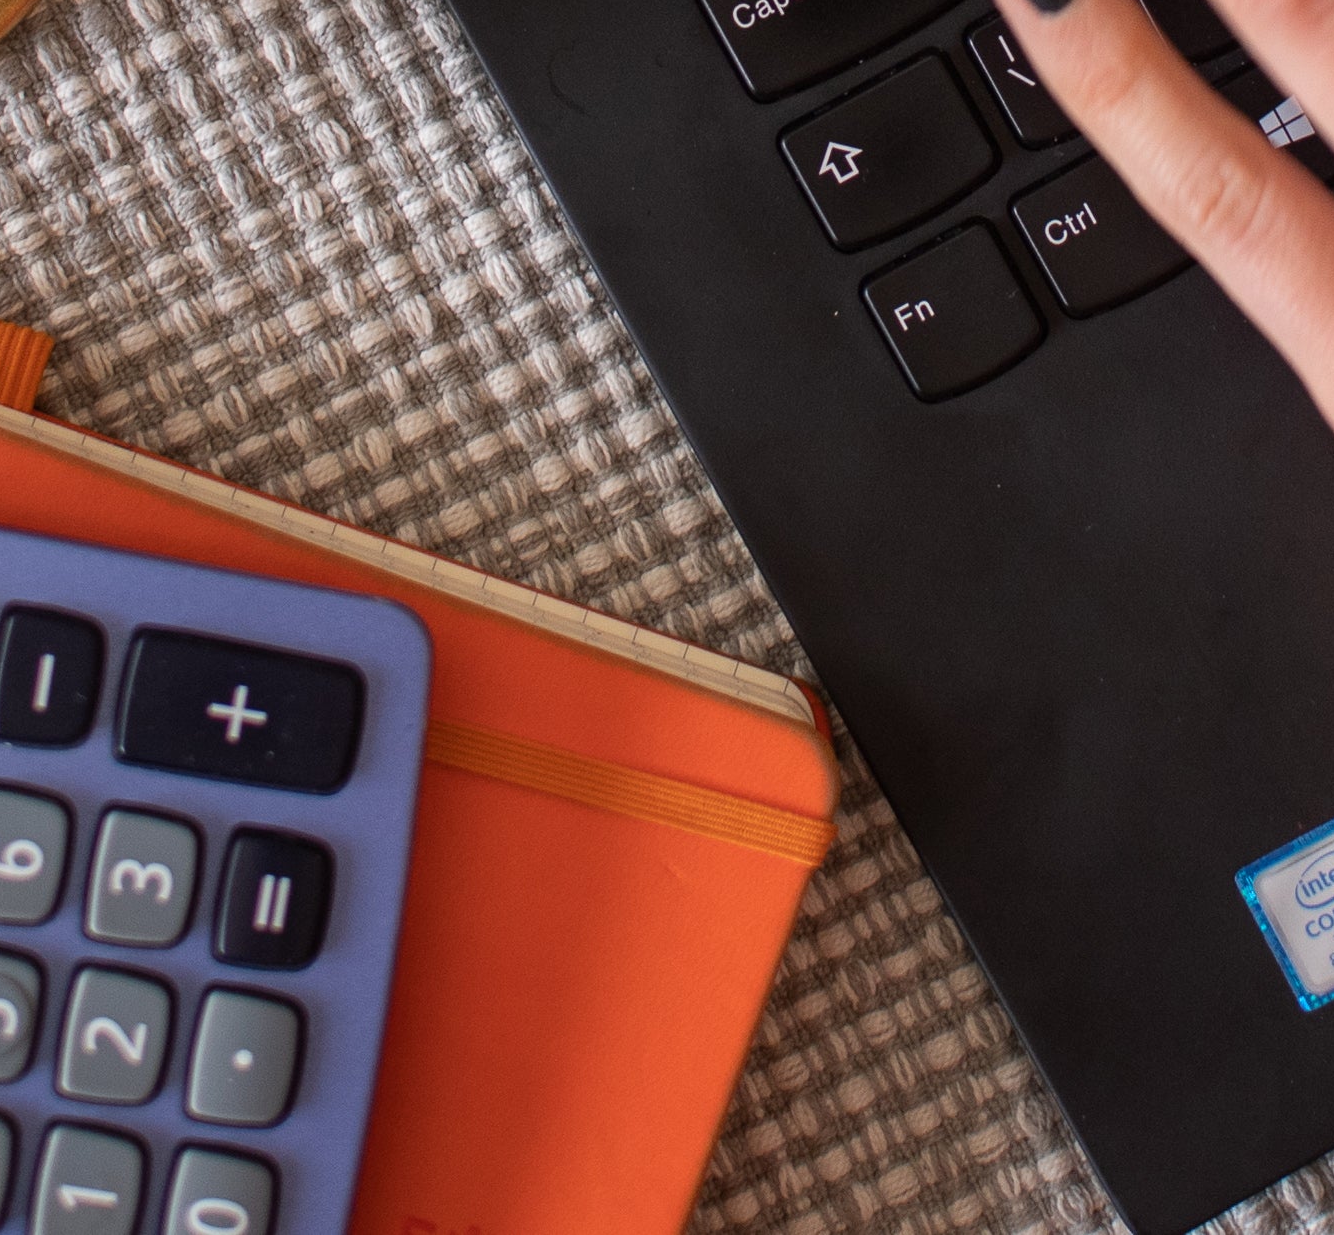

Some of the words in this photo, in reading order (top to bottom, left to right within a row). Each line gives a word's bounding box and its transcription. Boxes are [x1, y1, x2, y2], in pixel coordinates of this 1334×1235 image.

[1043, 202, 1098, 247] Ctrl
[894, 297, 935, 332] Fn
[107, 857, 175, 904] 3
[80, 1015, 149, 1067] 2
[57, 1182, 120, 1214] 1
[187, 1196, 250, 1235] 0
